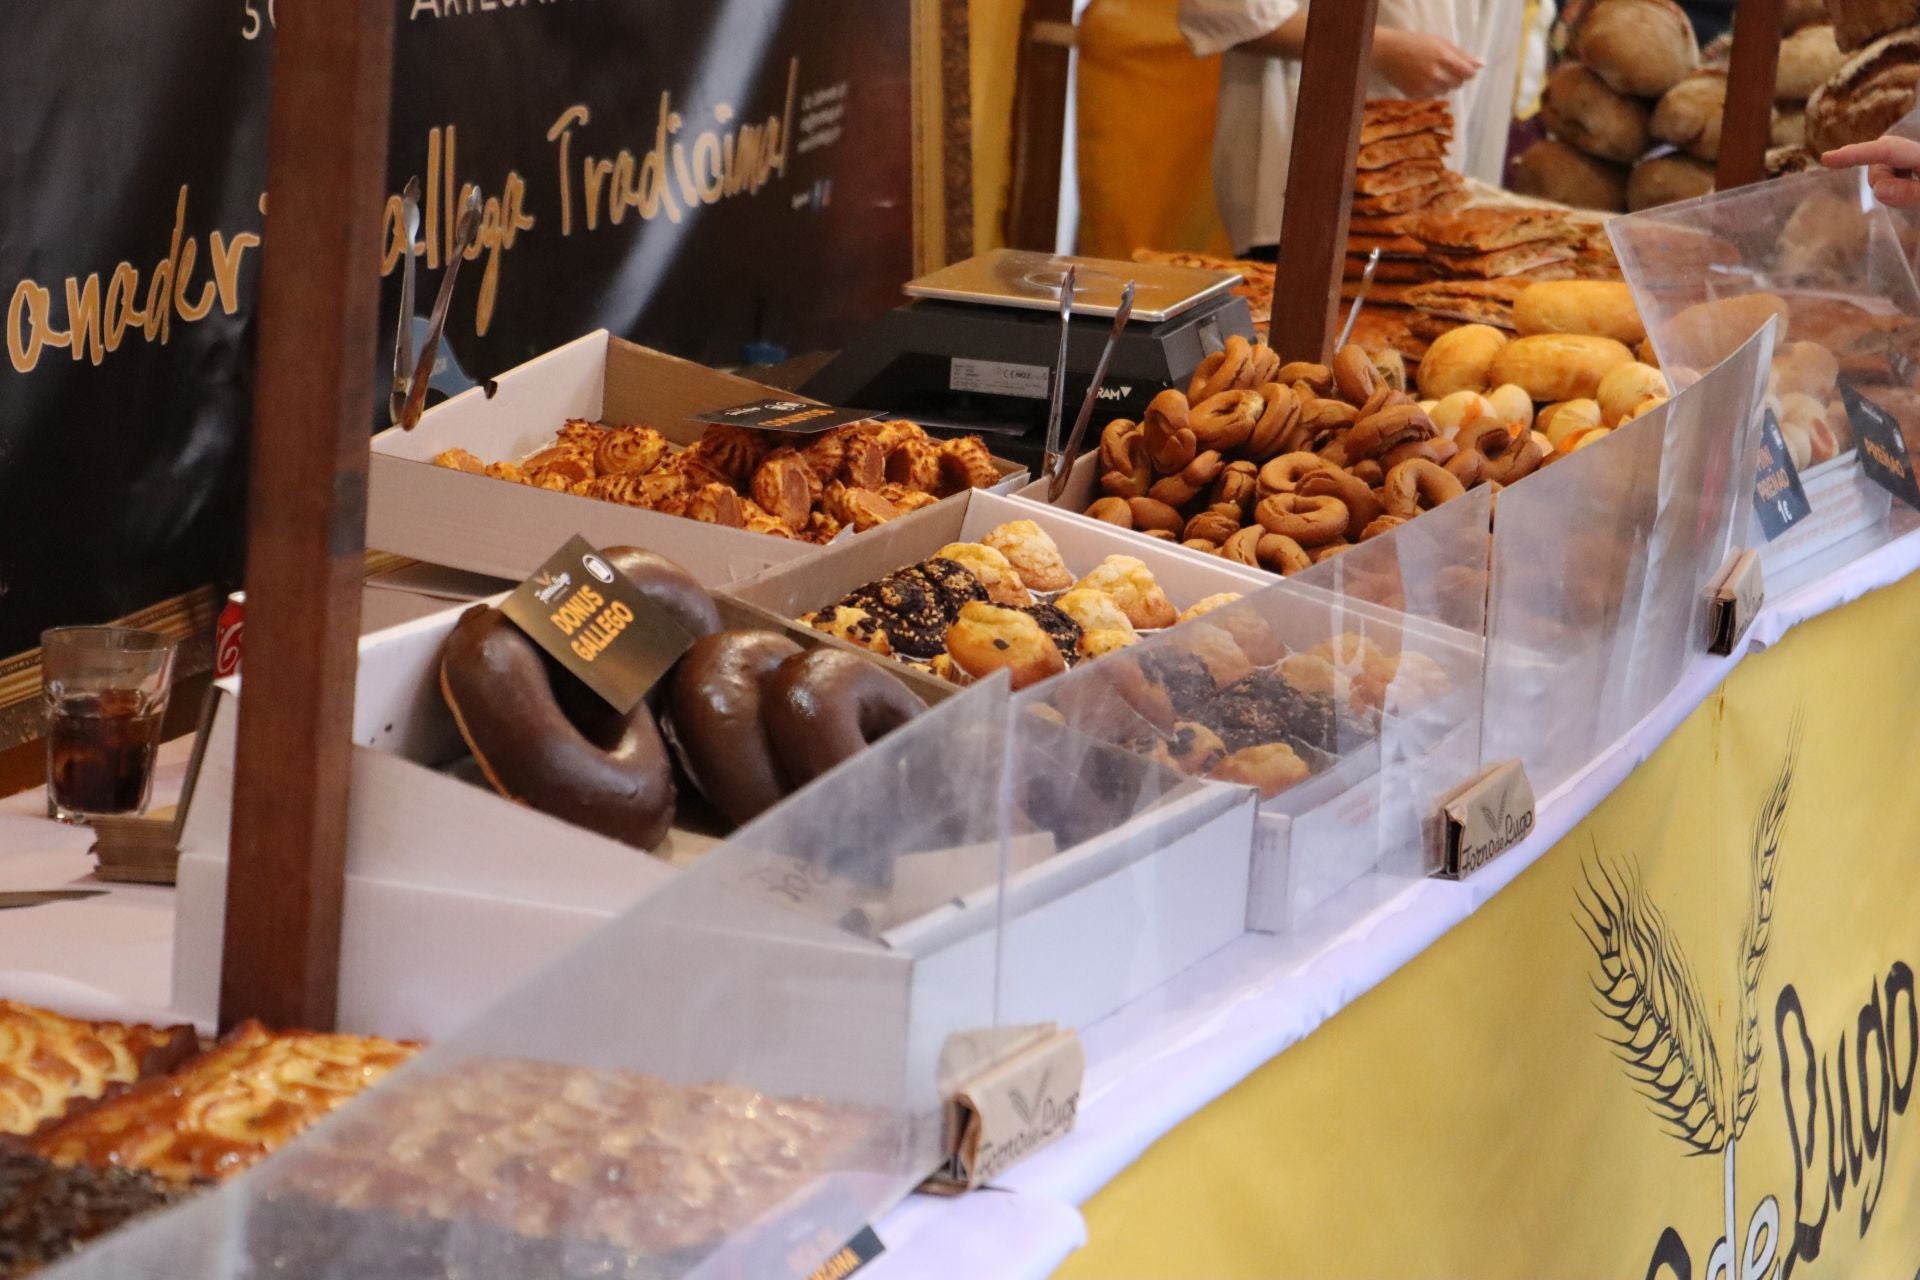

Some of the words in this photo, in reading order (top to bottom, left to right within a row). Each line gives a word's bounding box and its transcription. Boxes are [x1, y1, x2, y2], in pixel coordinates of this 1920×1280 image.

[7, 184, 268, 373] anader
[549, 584, 604, 636] DONUS
[570, 600, 634, 662] GALLEGO
[1503, 810, 1533, 847] Lugo
[1774, 960, 1918, 1280] Lugo
